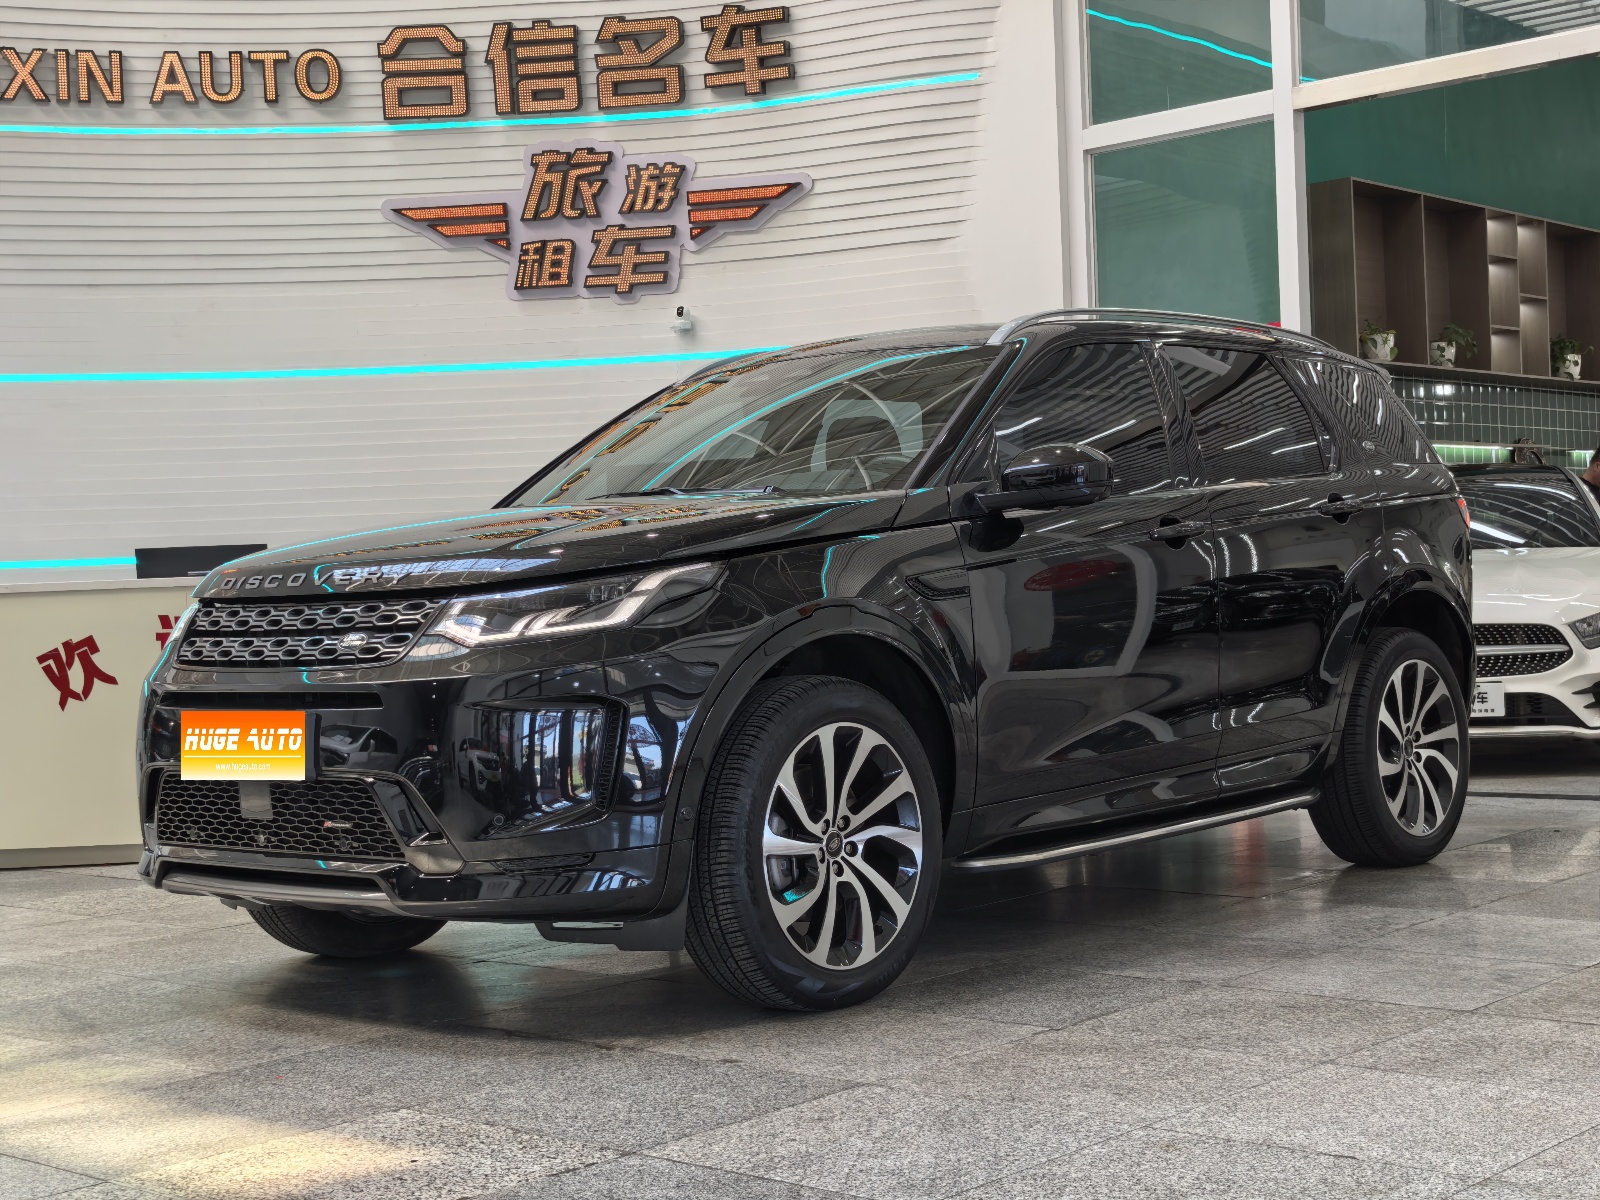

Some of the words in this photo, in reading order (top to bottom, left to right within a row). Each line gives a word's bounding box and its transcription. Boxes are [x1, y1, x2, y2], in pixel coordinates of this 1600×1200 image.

[0, 47, 125, 104] XIN
[149, 49, 342, 104] AUTO
[377, 5, 795, 120] 合信名车
[520, 147, 686, 222] 旅游
[514, 224, 676, 295] 租车
[220, 569, 413, 591] DISCOVERY
[36, 634, 119, 712] 欢
